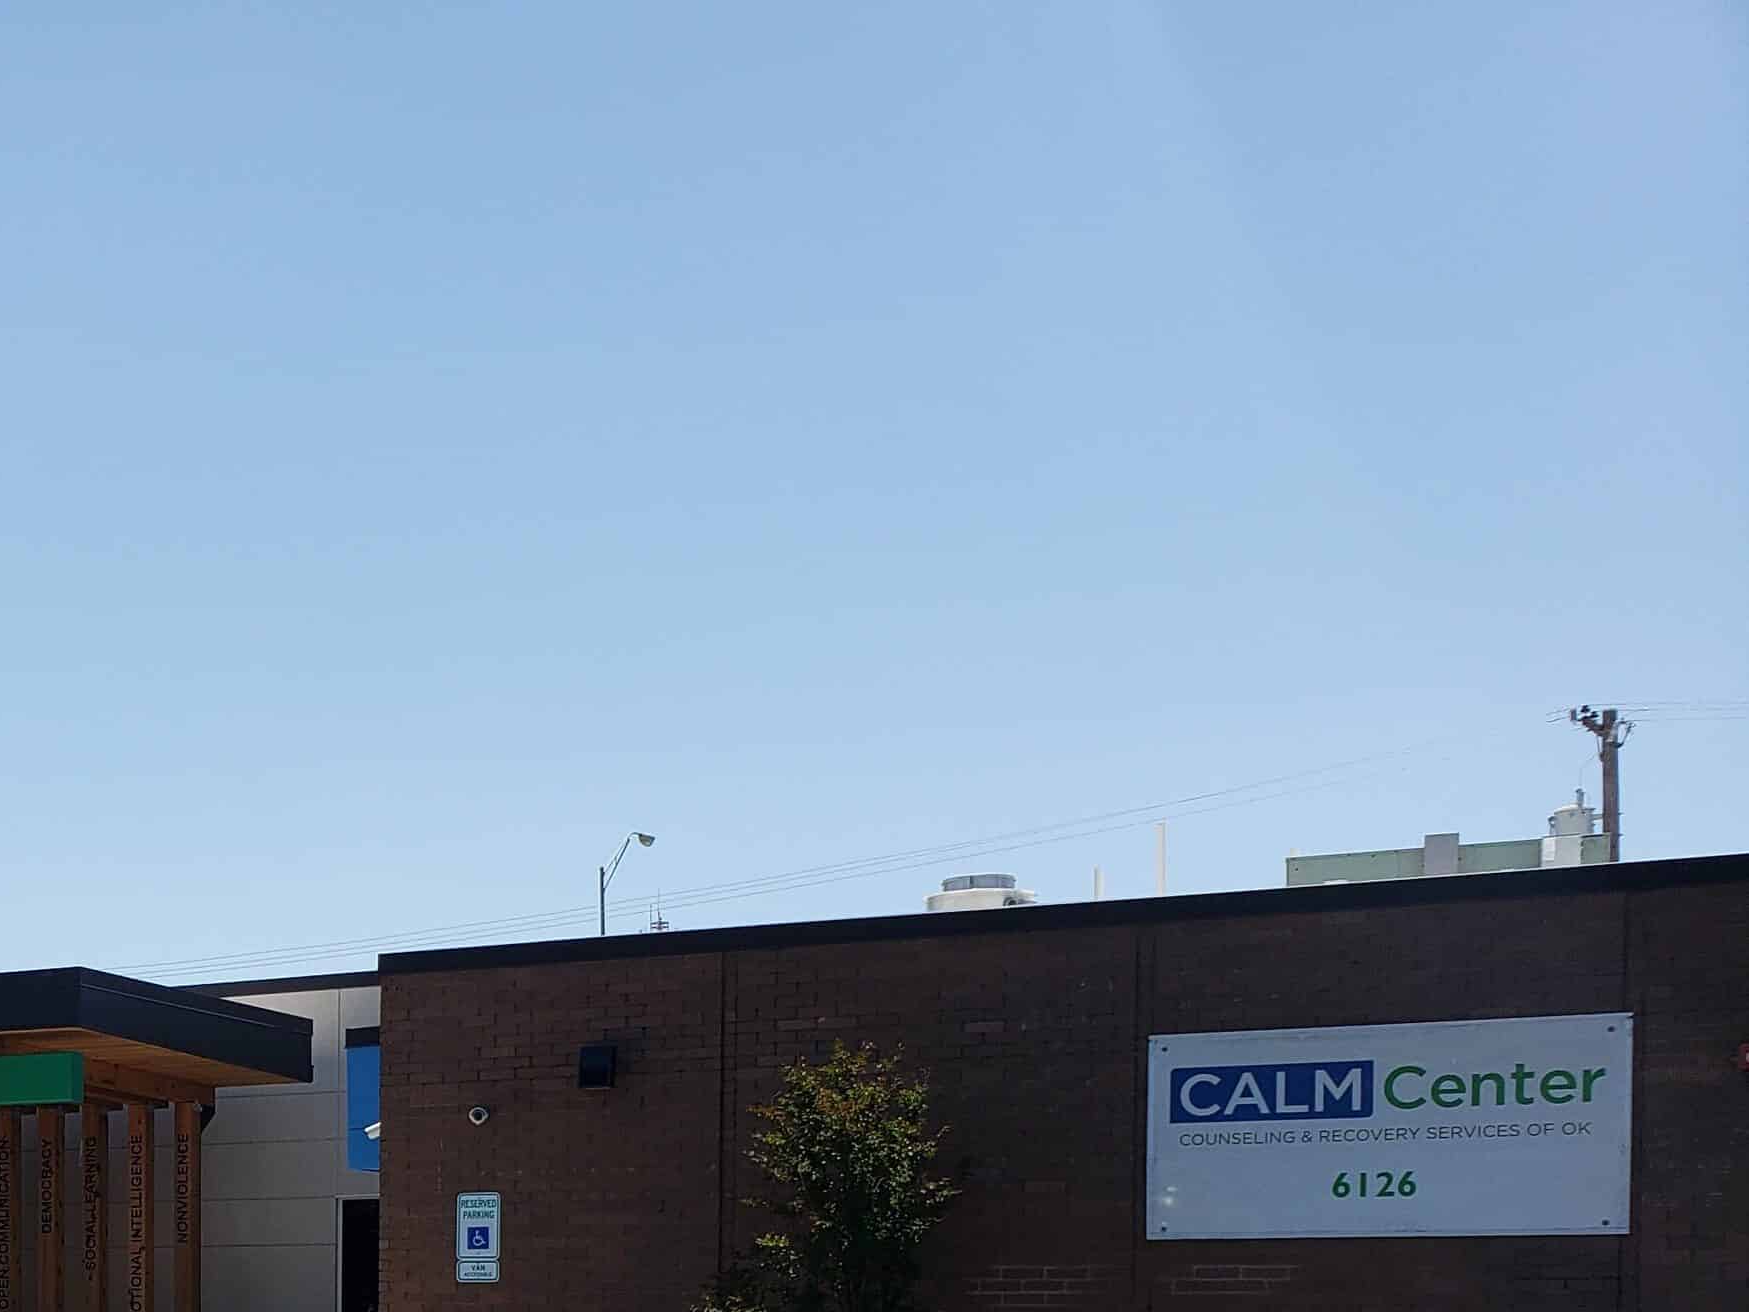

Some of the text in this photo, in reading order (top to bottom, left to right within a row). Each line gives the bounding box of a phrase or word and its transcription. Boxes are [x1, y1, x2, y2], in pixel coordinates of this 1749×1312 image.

[1180, 1063, 1607, 1117] CALM Center
[1179, 1121, 1592, 1146] COUNSELING & RECOVERY SERVICES OF OK
[41, 1138, 52, 1234] DEMOCRACY
[85, 1135, 98, 1271] SOCIAL LEARNING
[130, 1135, 143, 1242] INTELLIGENCE
[177, 1133, 188, 1243] NONVIOLENCE
[460, 1199, 497, 1209] RESERVED
[1332, 1171, 1417, 1198] 6126
[463, 1210, 495, 1219] PARKING
